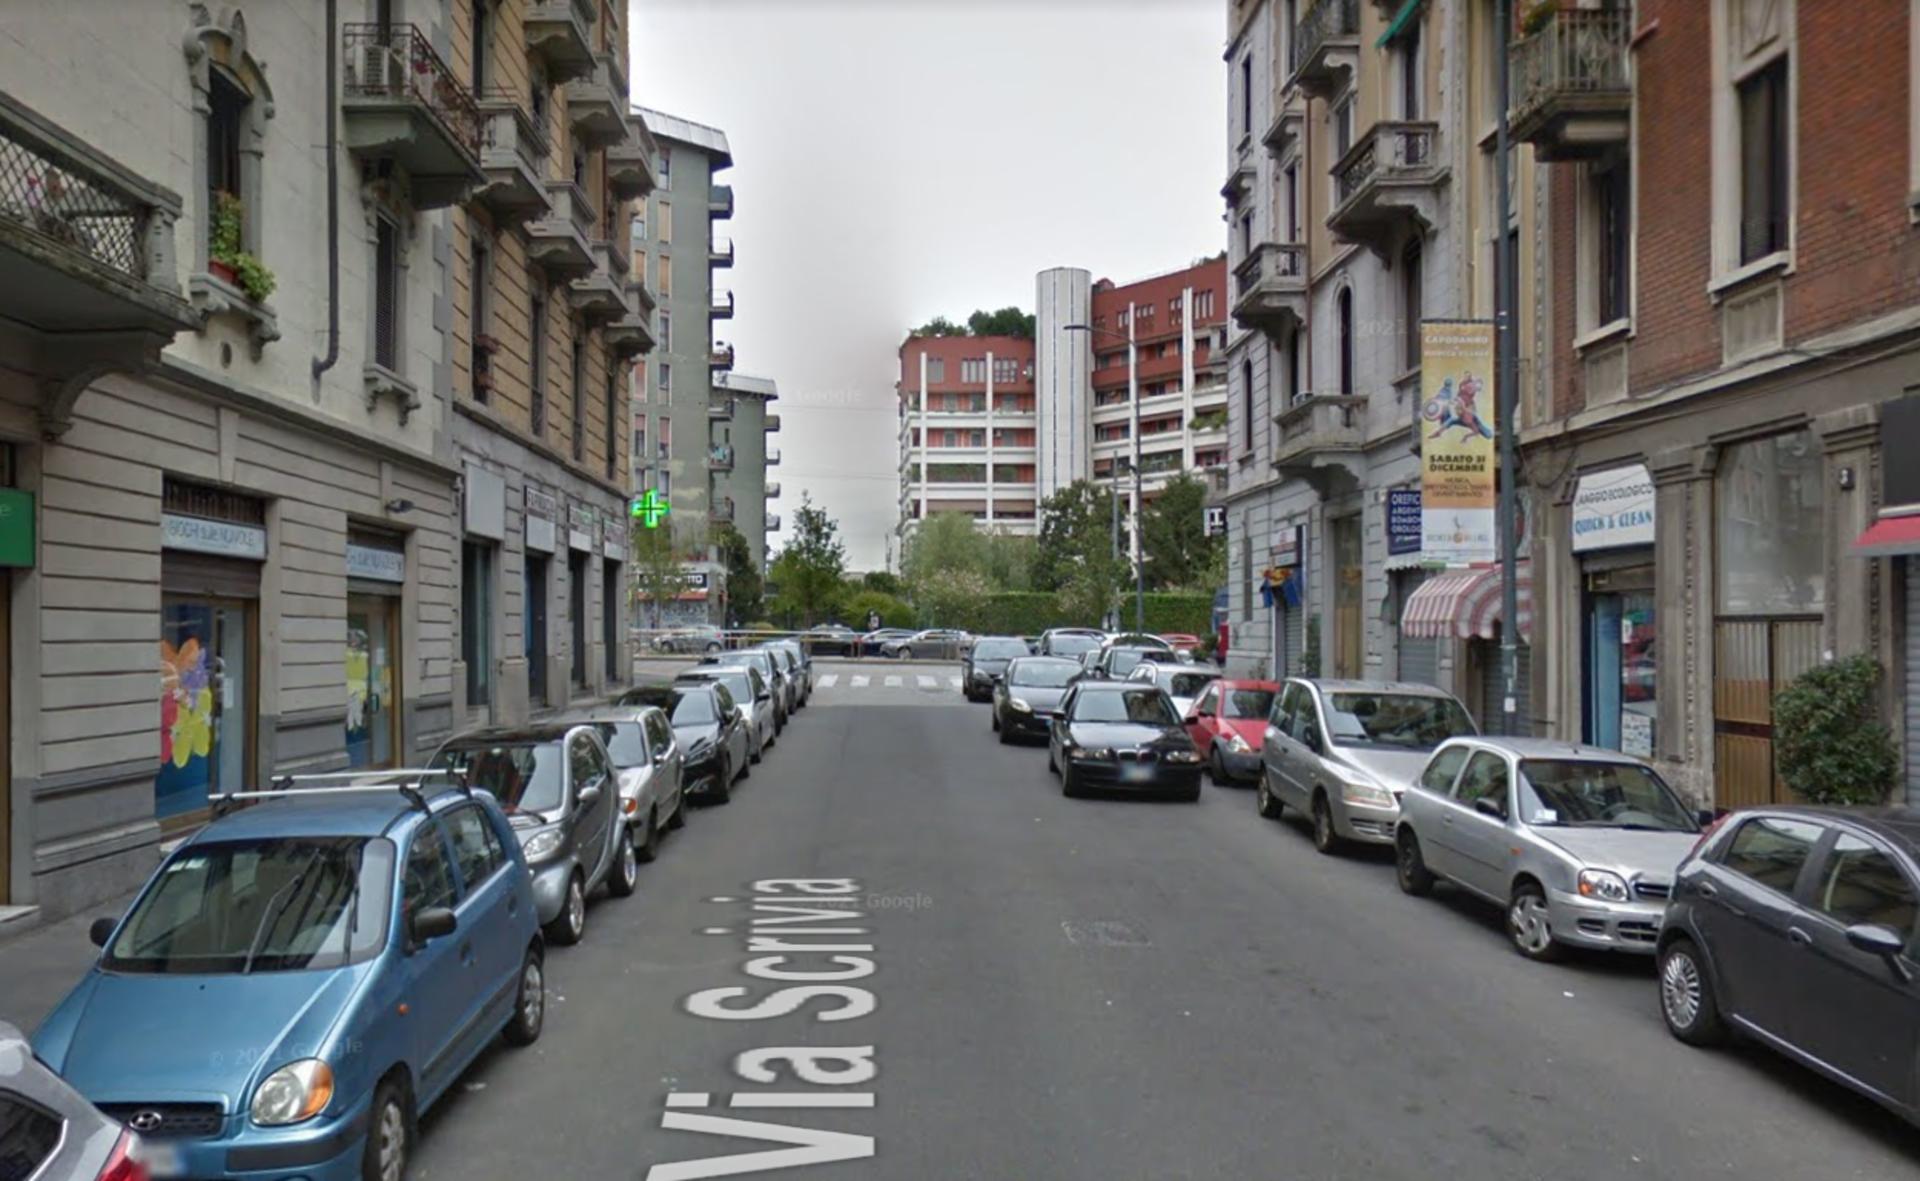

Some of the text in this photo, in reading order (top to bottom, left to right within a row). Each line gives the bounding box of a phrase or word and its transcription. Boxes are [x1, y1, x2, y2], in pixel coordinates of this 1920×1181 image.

[1429, 454, 1474, 463] SABATO
[1429, 463, 1485, 473] DICEMBRE
[1391, 494, 1421, 505] OREFIC
[1618, 511, 1652, 528] CLEAN
